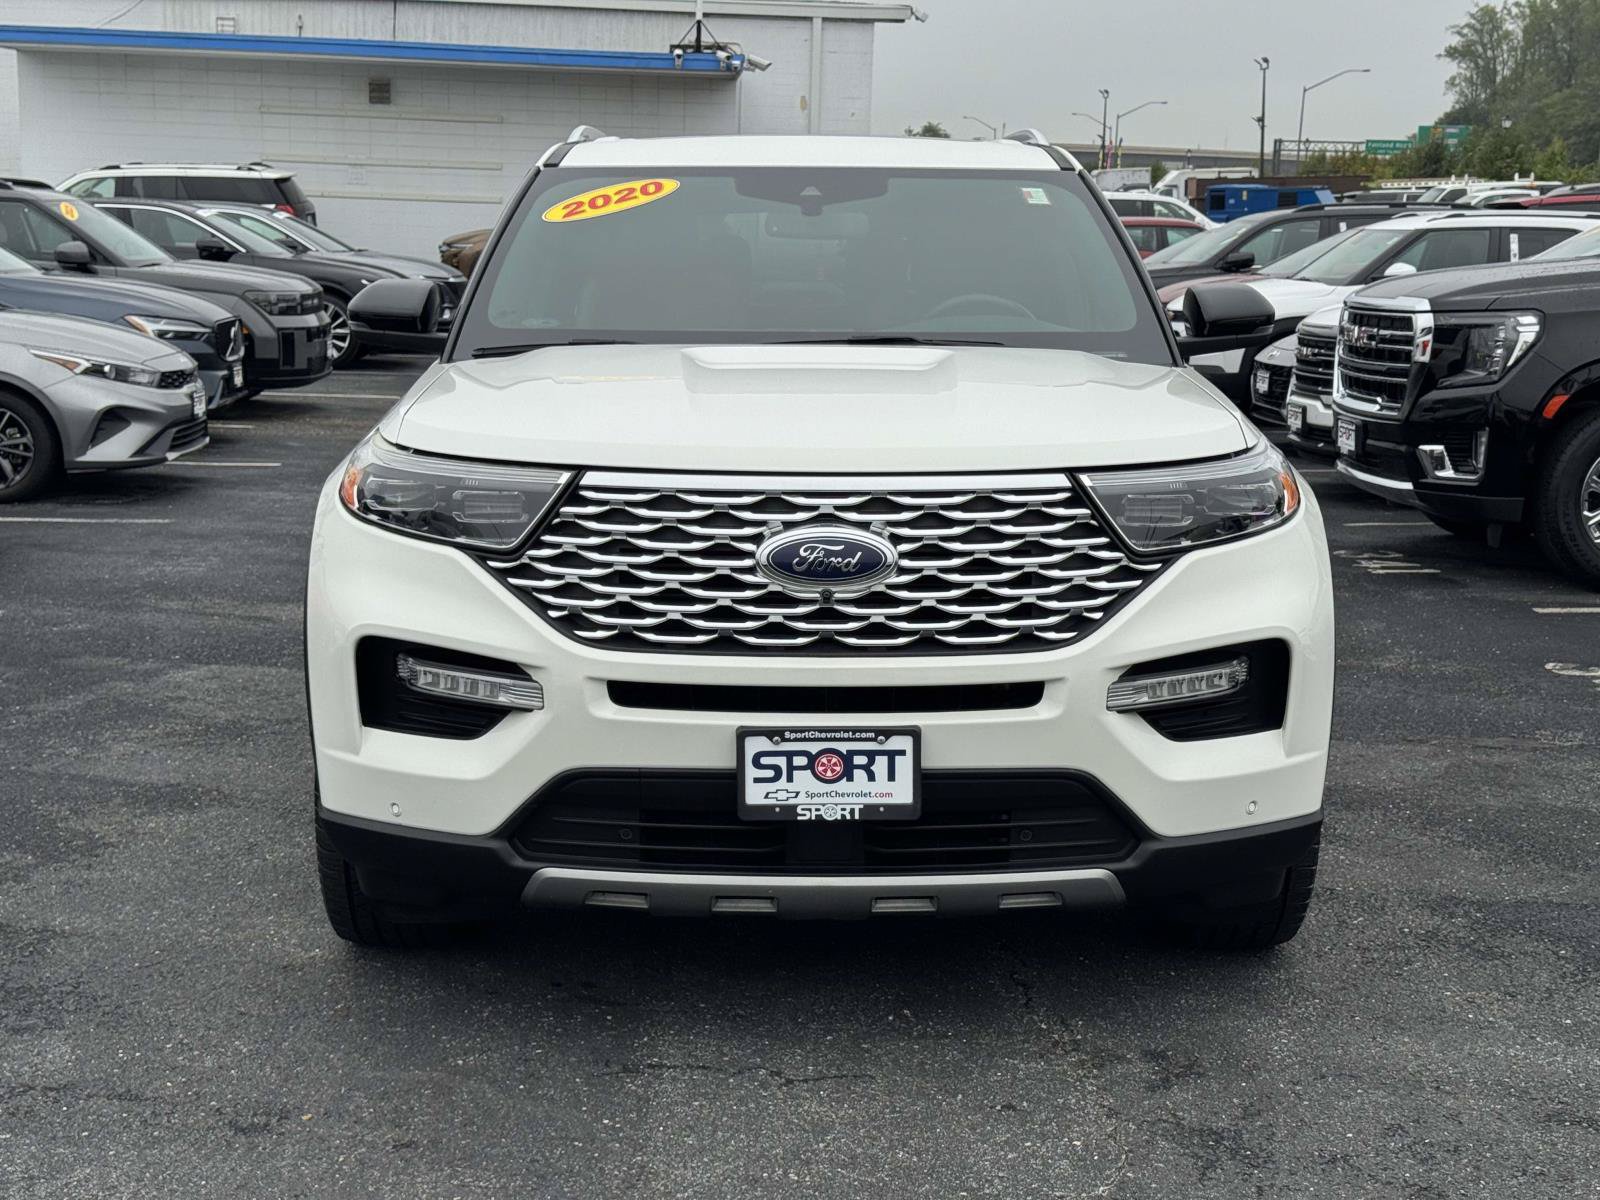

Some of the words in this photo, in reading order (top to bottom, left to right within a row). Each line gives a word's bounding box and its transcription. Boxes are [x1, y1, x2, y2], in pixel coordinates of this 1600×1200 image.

[562, 181, 664, 219] 2020
[792, 543, 862, 572] Ford
[784, 731, 875, 739] SportChevrolet.com
[751, 747, 906, 784] SPORT
[805, 790, 893, 800] SportChevrolet.com
[796, 803, 864, 820] SPORT
